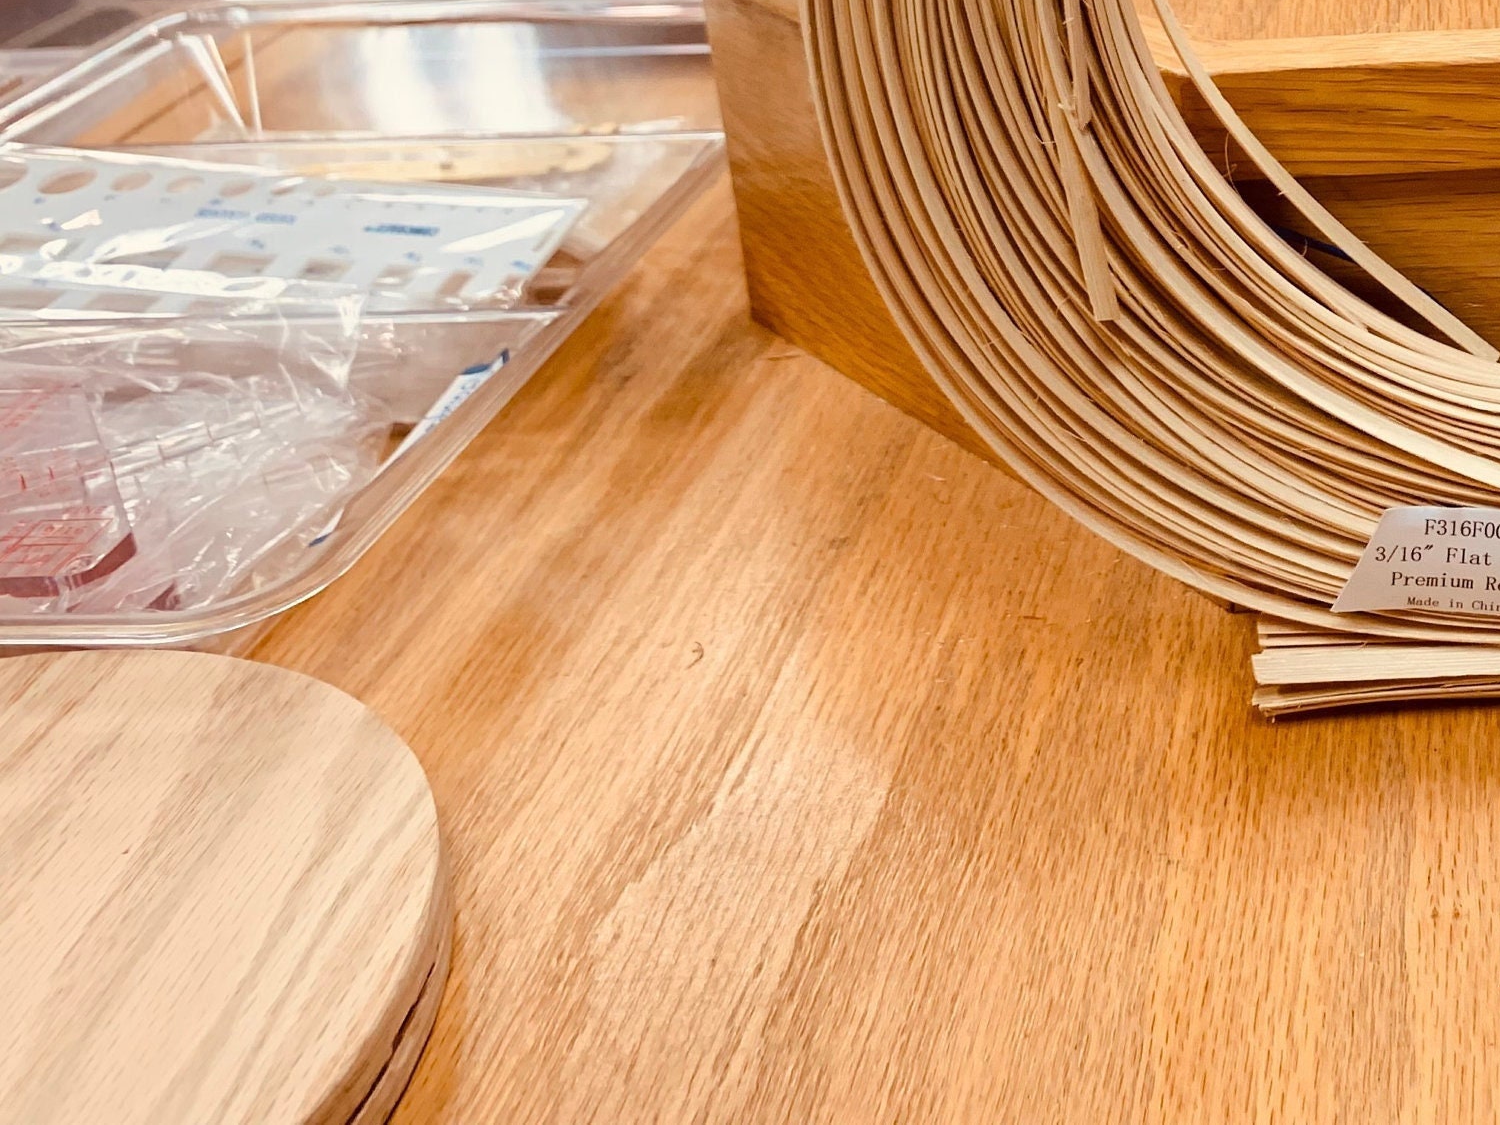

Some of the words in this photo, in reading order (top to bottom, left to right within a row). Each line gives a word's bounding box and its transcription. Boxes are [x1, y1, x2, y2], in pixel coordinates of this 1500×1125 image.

[1446, 547, 1492, 566] Flat
[1391, 572, 1474, 589] Premium
[1407, 596, 1440, 607] Made
[1450, 599, 1464, 608] in
